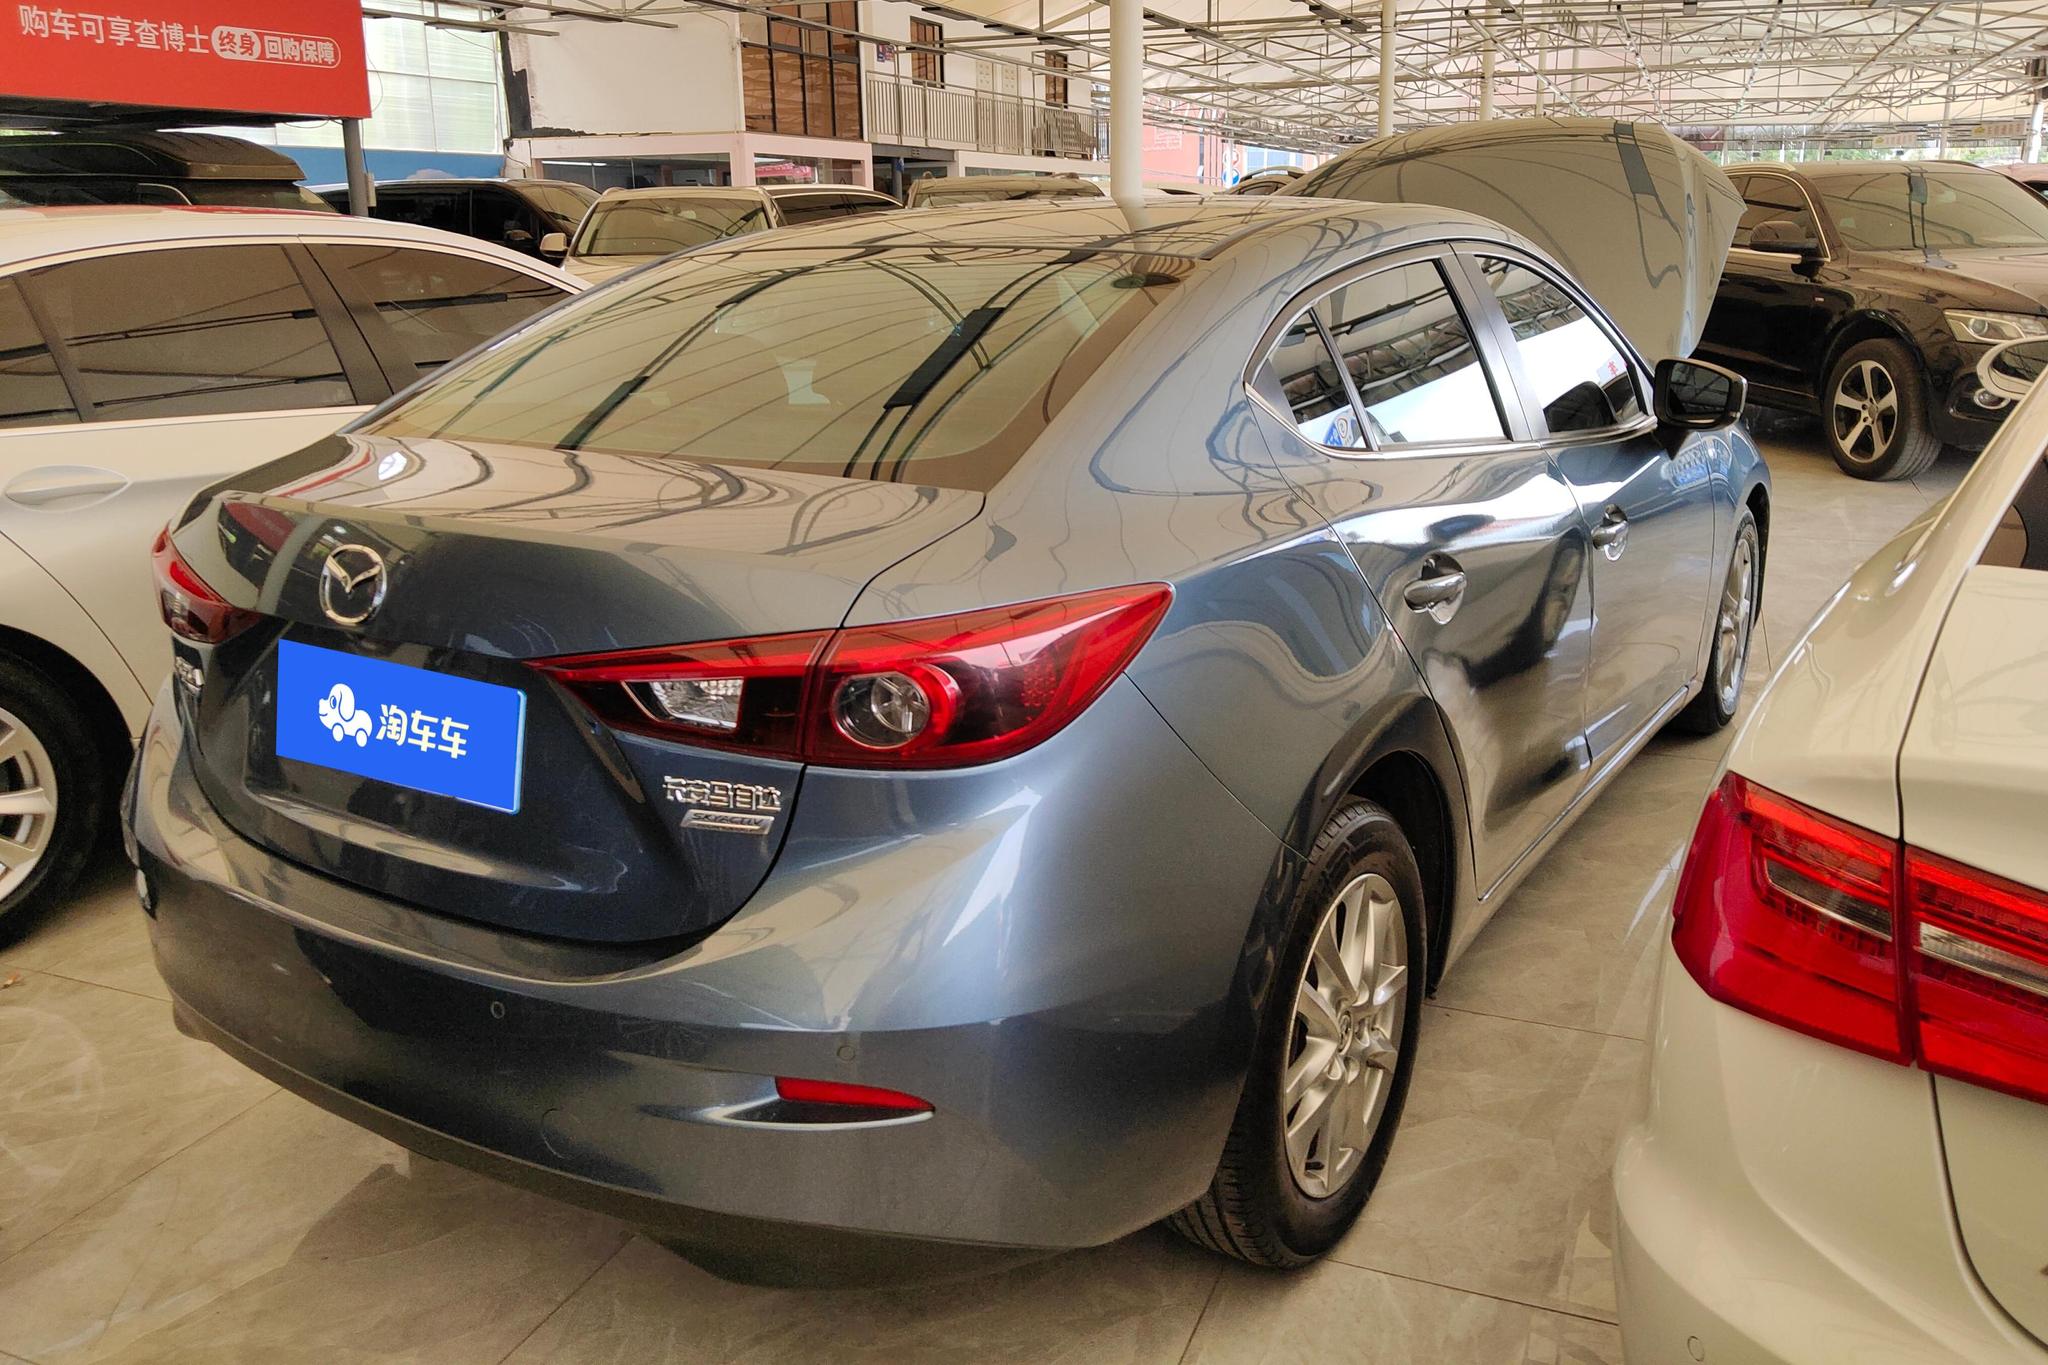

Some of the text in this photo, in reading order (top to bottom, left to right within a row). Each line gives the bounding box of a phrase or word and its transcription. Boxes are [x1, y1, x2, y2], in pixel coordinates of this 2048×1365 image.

[18, 5, 336, 65] 购车可享查博士 终身 回购保障
